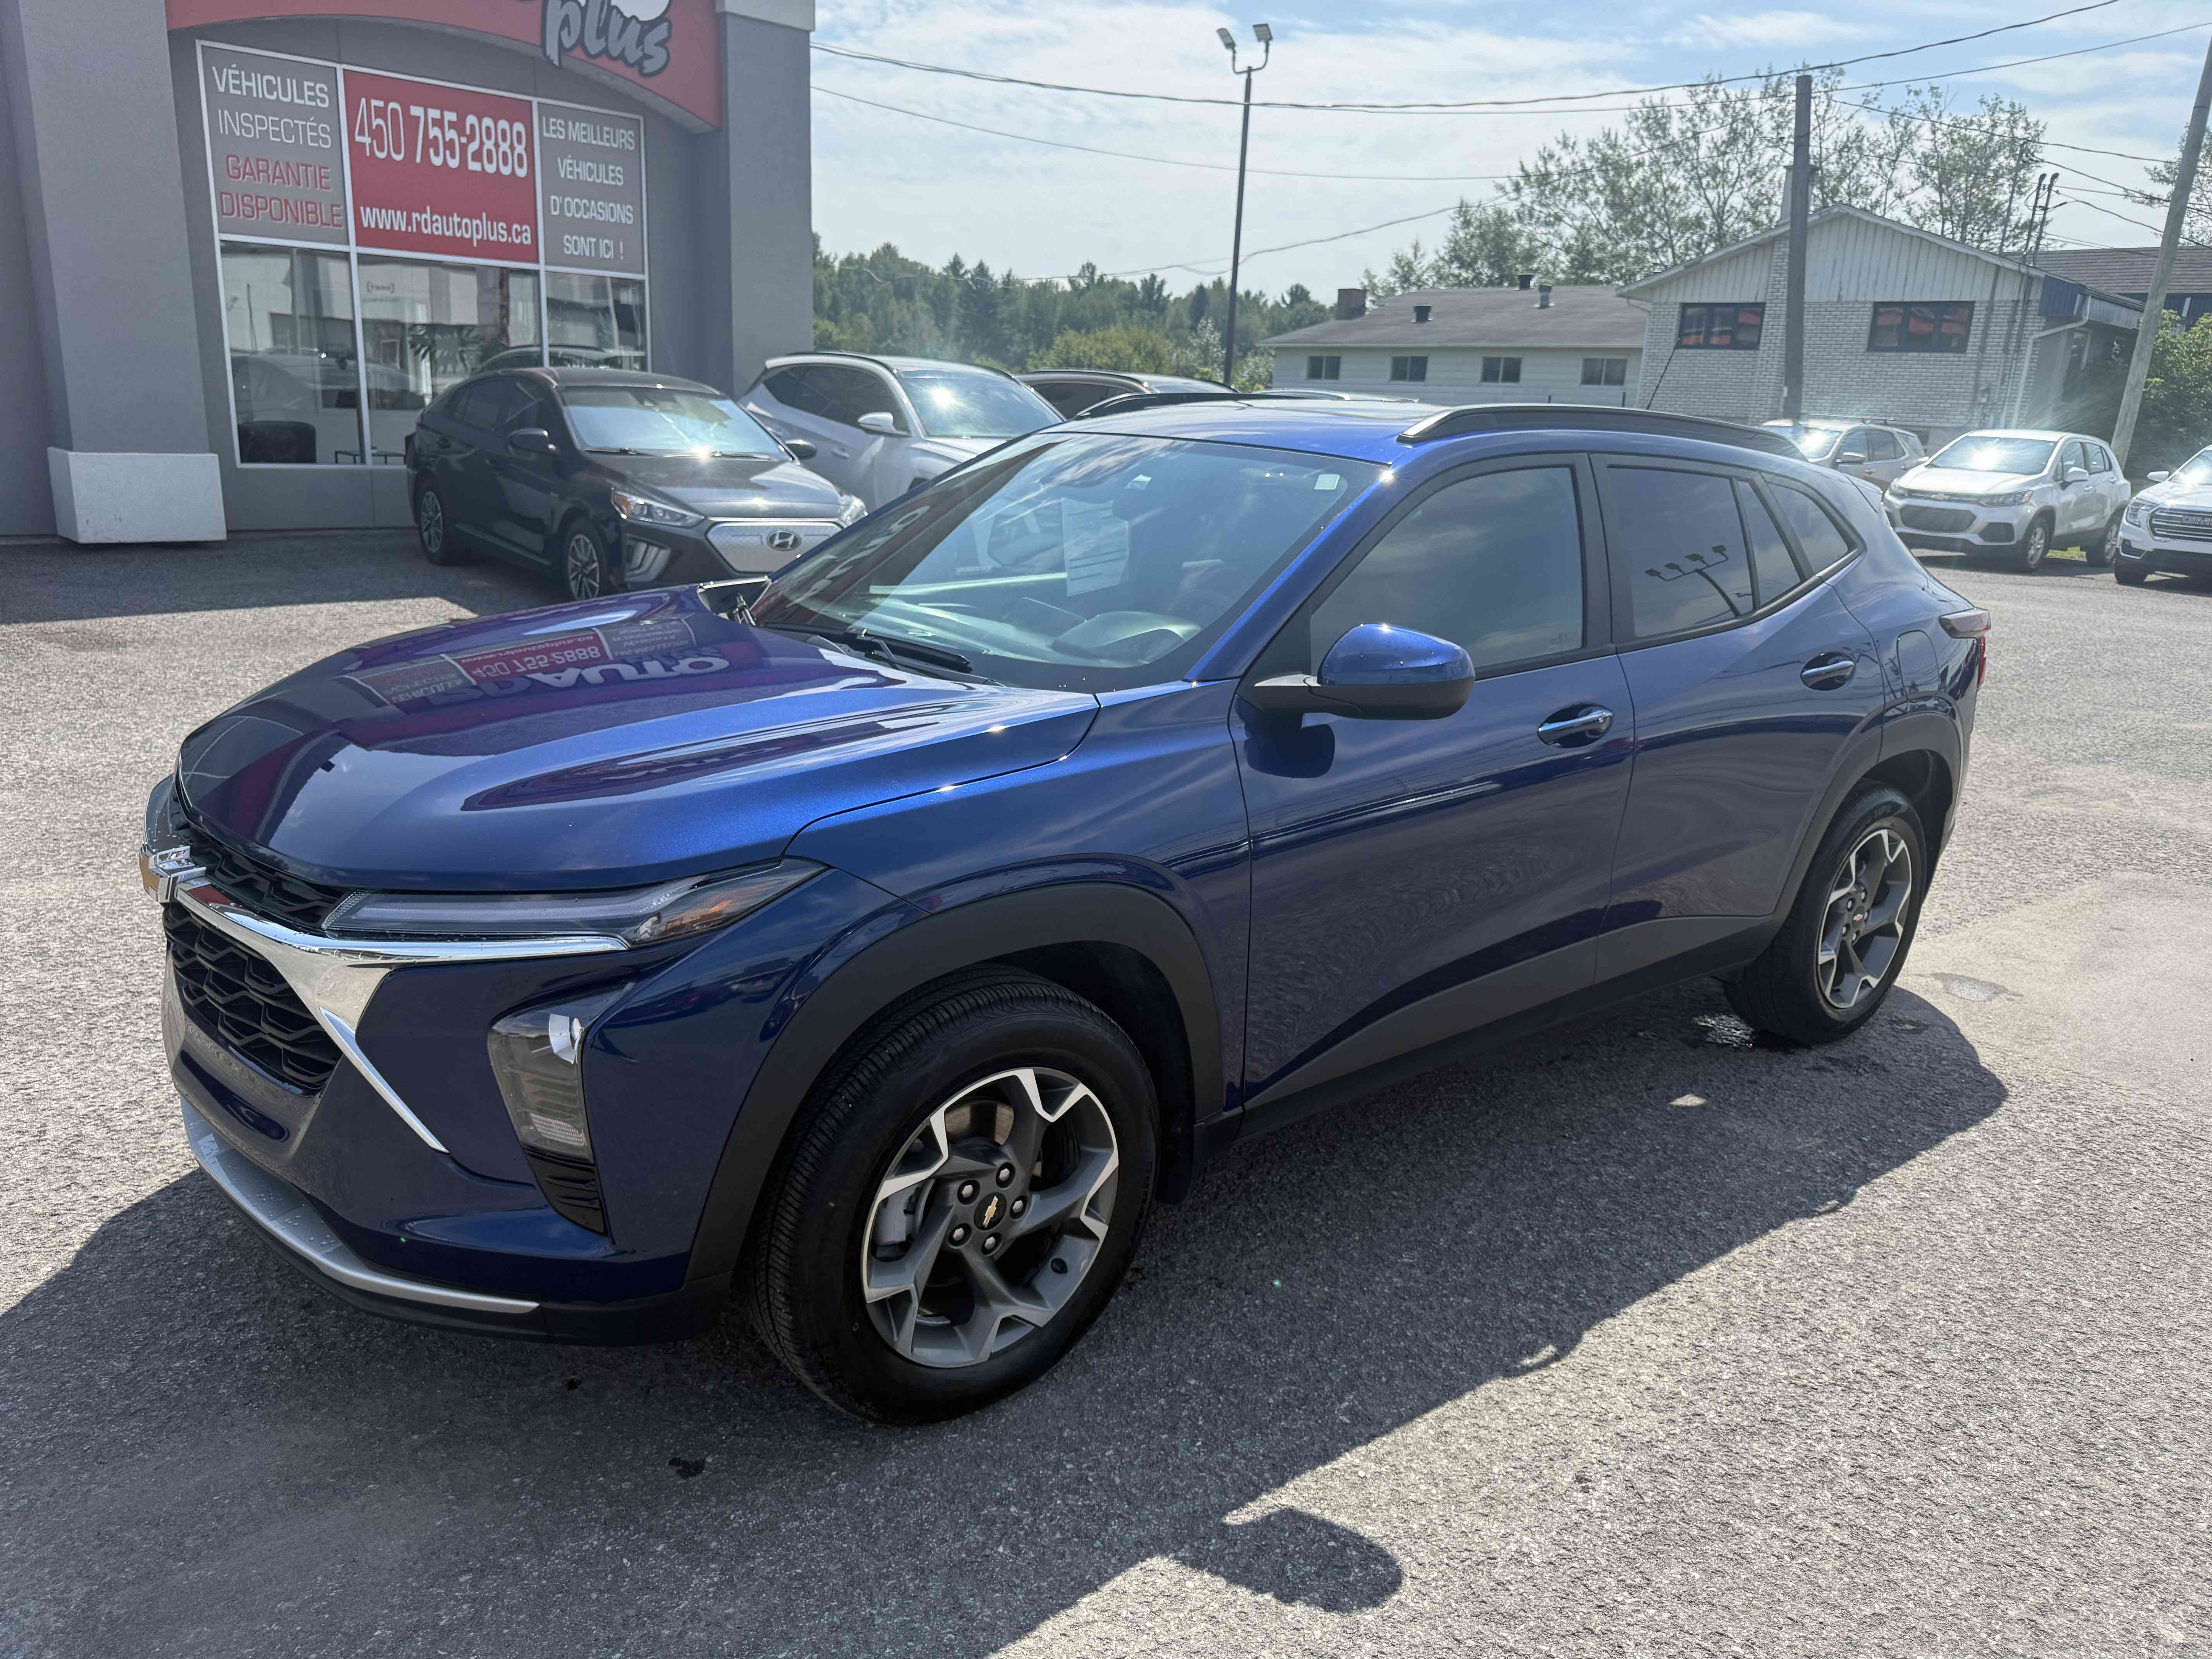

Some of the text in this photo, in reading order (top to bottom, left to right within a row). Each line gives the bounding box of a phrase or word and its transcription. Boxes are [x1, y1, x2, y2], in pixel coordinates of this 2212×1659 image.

[212, 64, 329, 108] VÉHICULES
[218, 109, 331, 148] INSPECTÉS
[355, 97, 528, 178] 450 755-2888
[542, 116, 635, 150] LES MEILLEURS
[226, 154, 332, 192] GARANTIE
[557, 155, 624, 186] VÉHICULES
[220, 192, 344, 229] DISPONIBLE
[360, 205, 531, 247] www.rdautoplus.ca
[563, 234, 597, 257] SONT
[599, 239, 614, 260] ICI
[2181, 515, 2212, 526] GM
